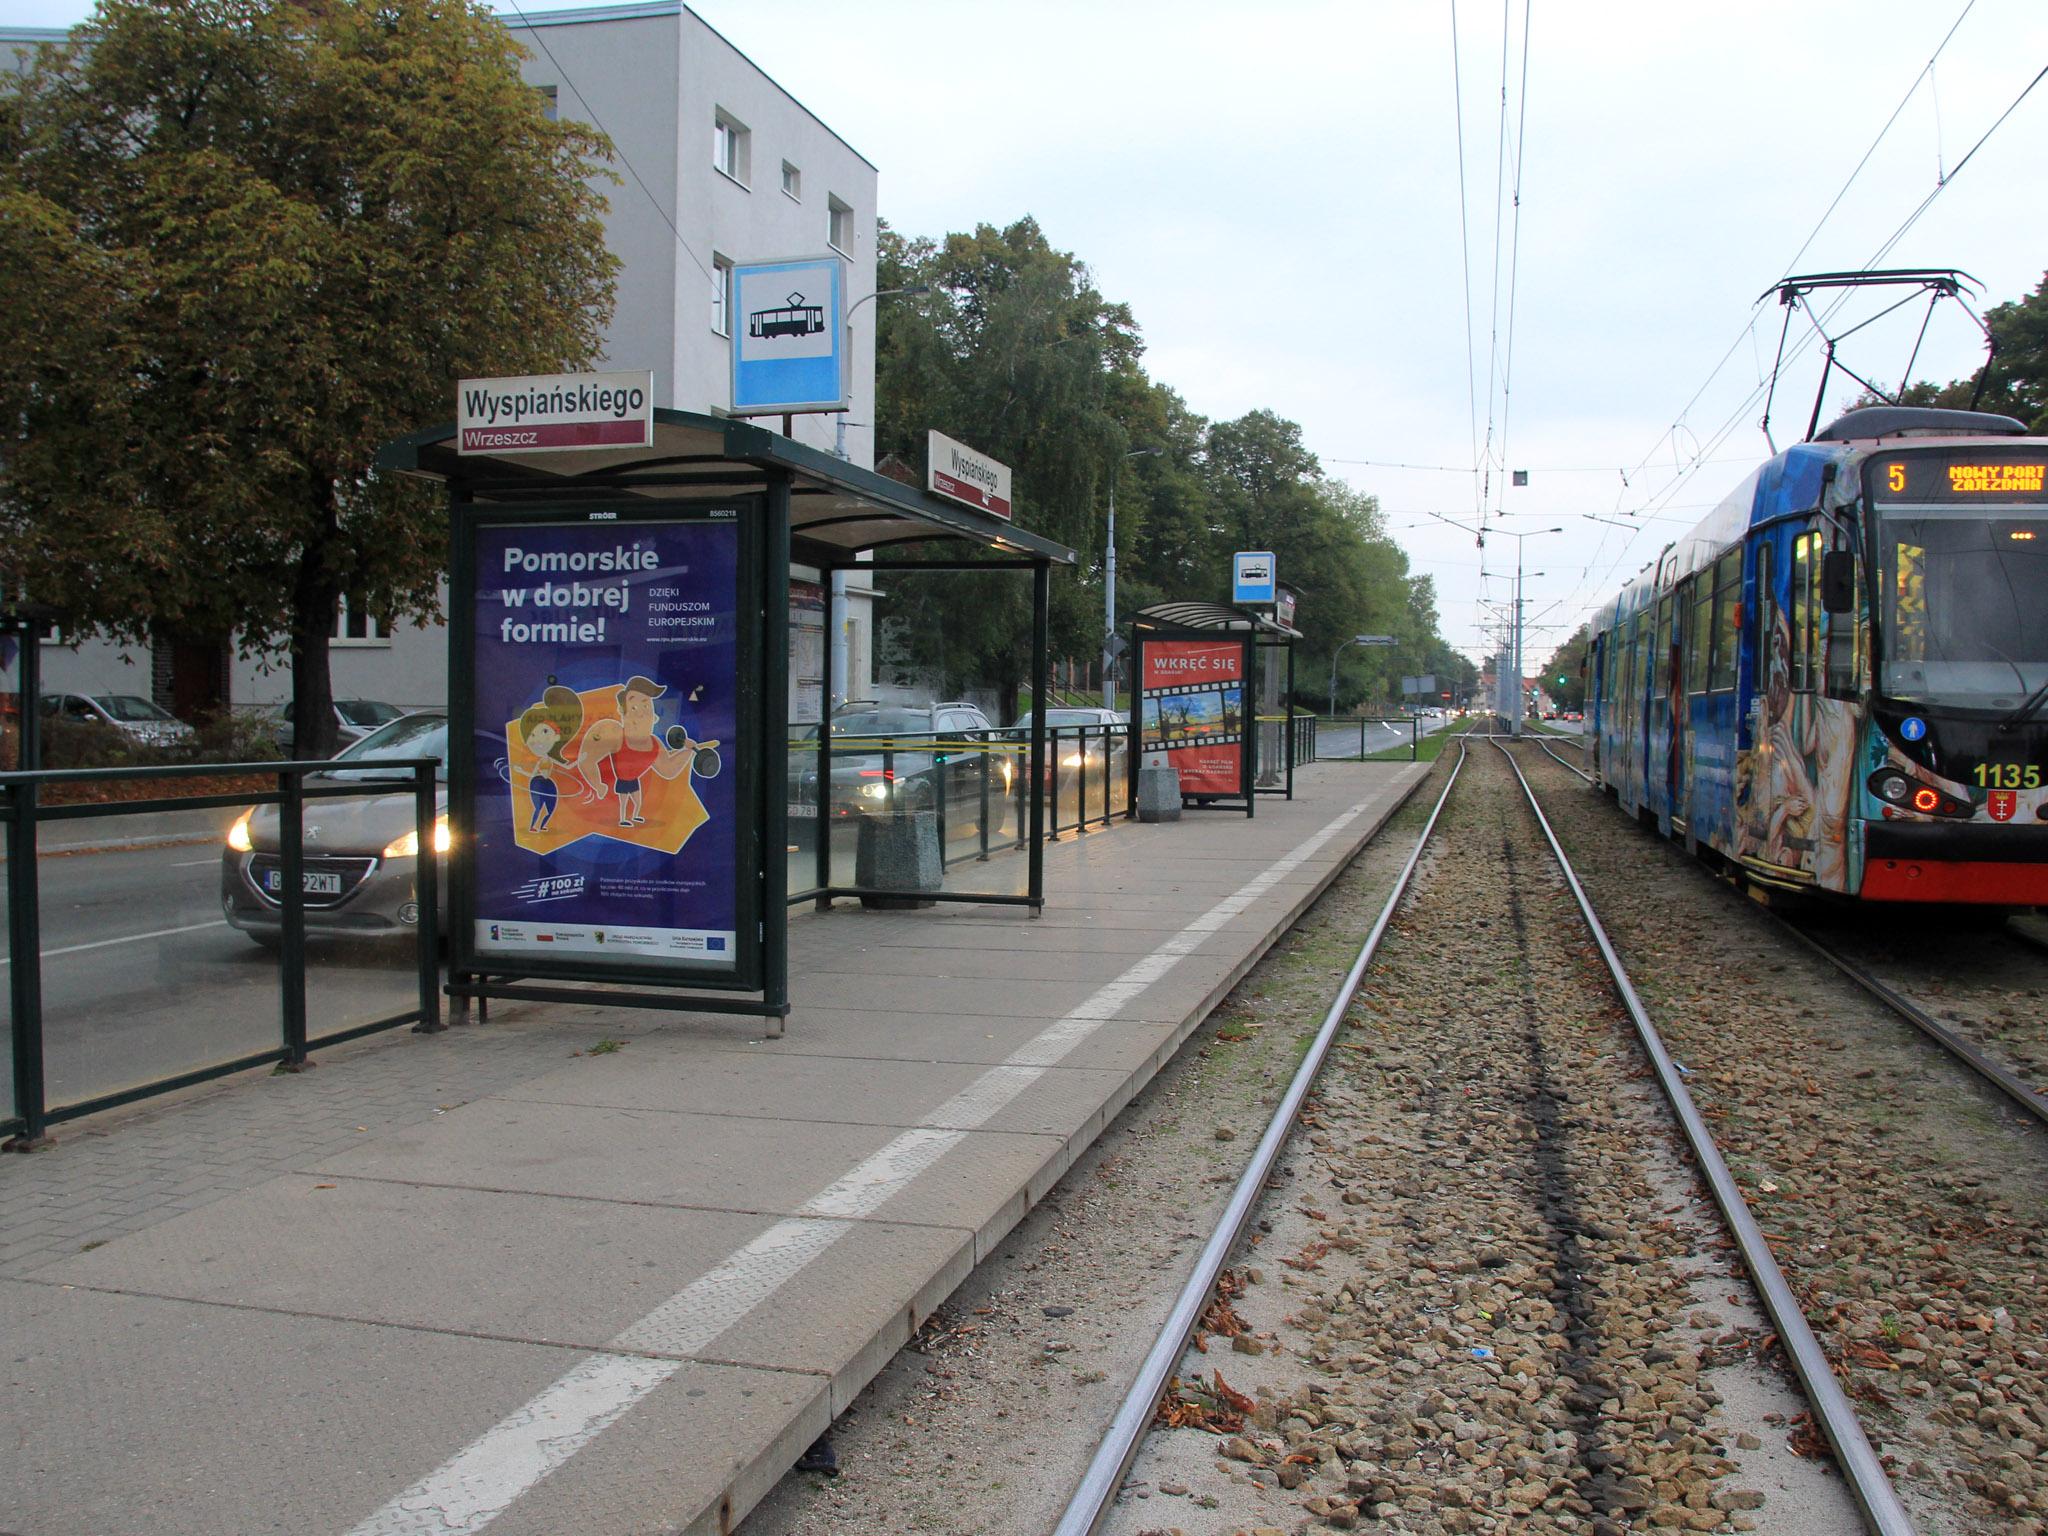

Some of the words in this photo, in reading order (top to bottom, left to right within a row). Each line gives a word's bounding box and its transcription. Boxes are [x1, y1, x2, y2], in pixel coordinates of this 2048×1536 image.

[465, 384, 644, 424] Wyspiańskiego
[465, 431, 538, 447] Wrzeszcz
[1888, 464, 1905, 492] 5
[1949, 465, 2001, 479] NOWY
[2003, 465, 2046, 479] PORT
[1952, 478, 2042, 491] ZAJEZDNIA
[503, 544, 660, 572] Pomorskie
[502, 588, 527, 607] w
[533, 580, 630, 613] dobrej
[649, 588, 680, 598] DZIĘKI
[648, 602, 710, 612] FUNDUSZOM
[500, 616, 606, 643] formie!
[648, 617, 715, 627] EUROPEJSKIM
[1154, 656, 1206, 671] WKRĘĆ
[1212, 658, 1235, 671] SIĘ
[1974, 763, 2041, 788] 1135
[573, 876, 585, 887] zł
